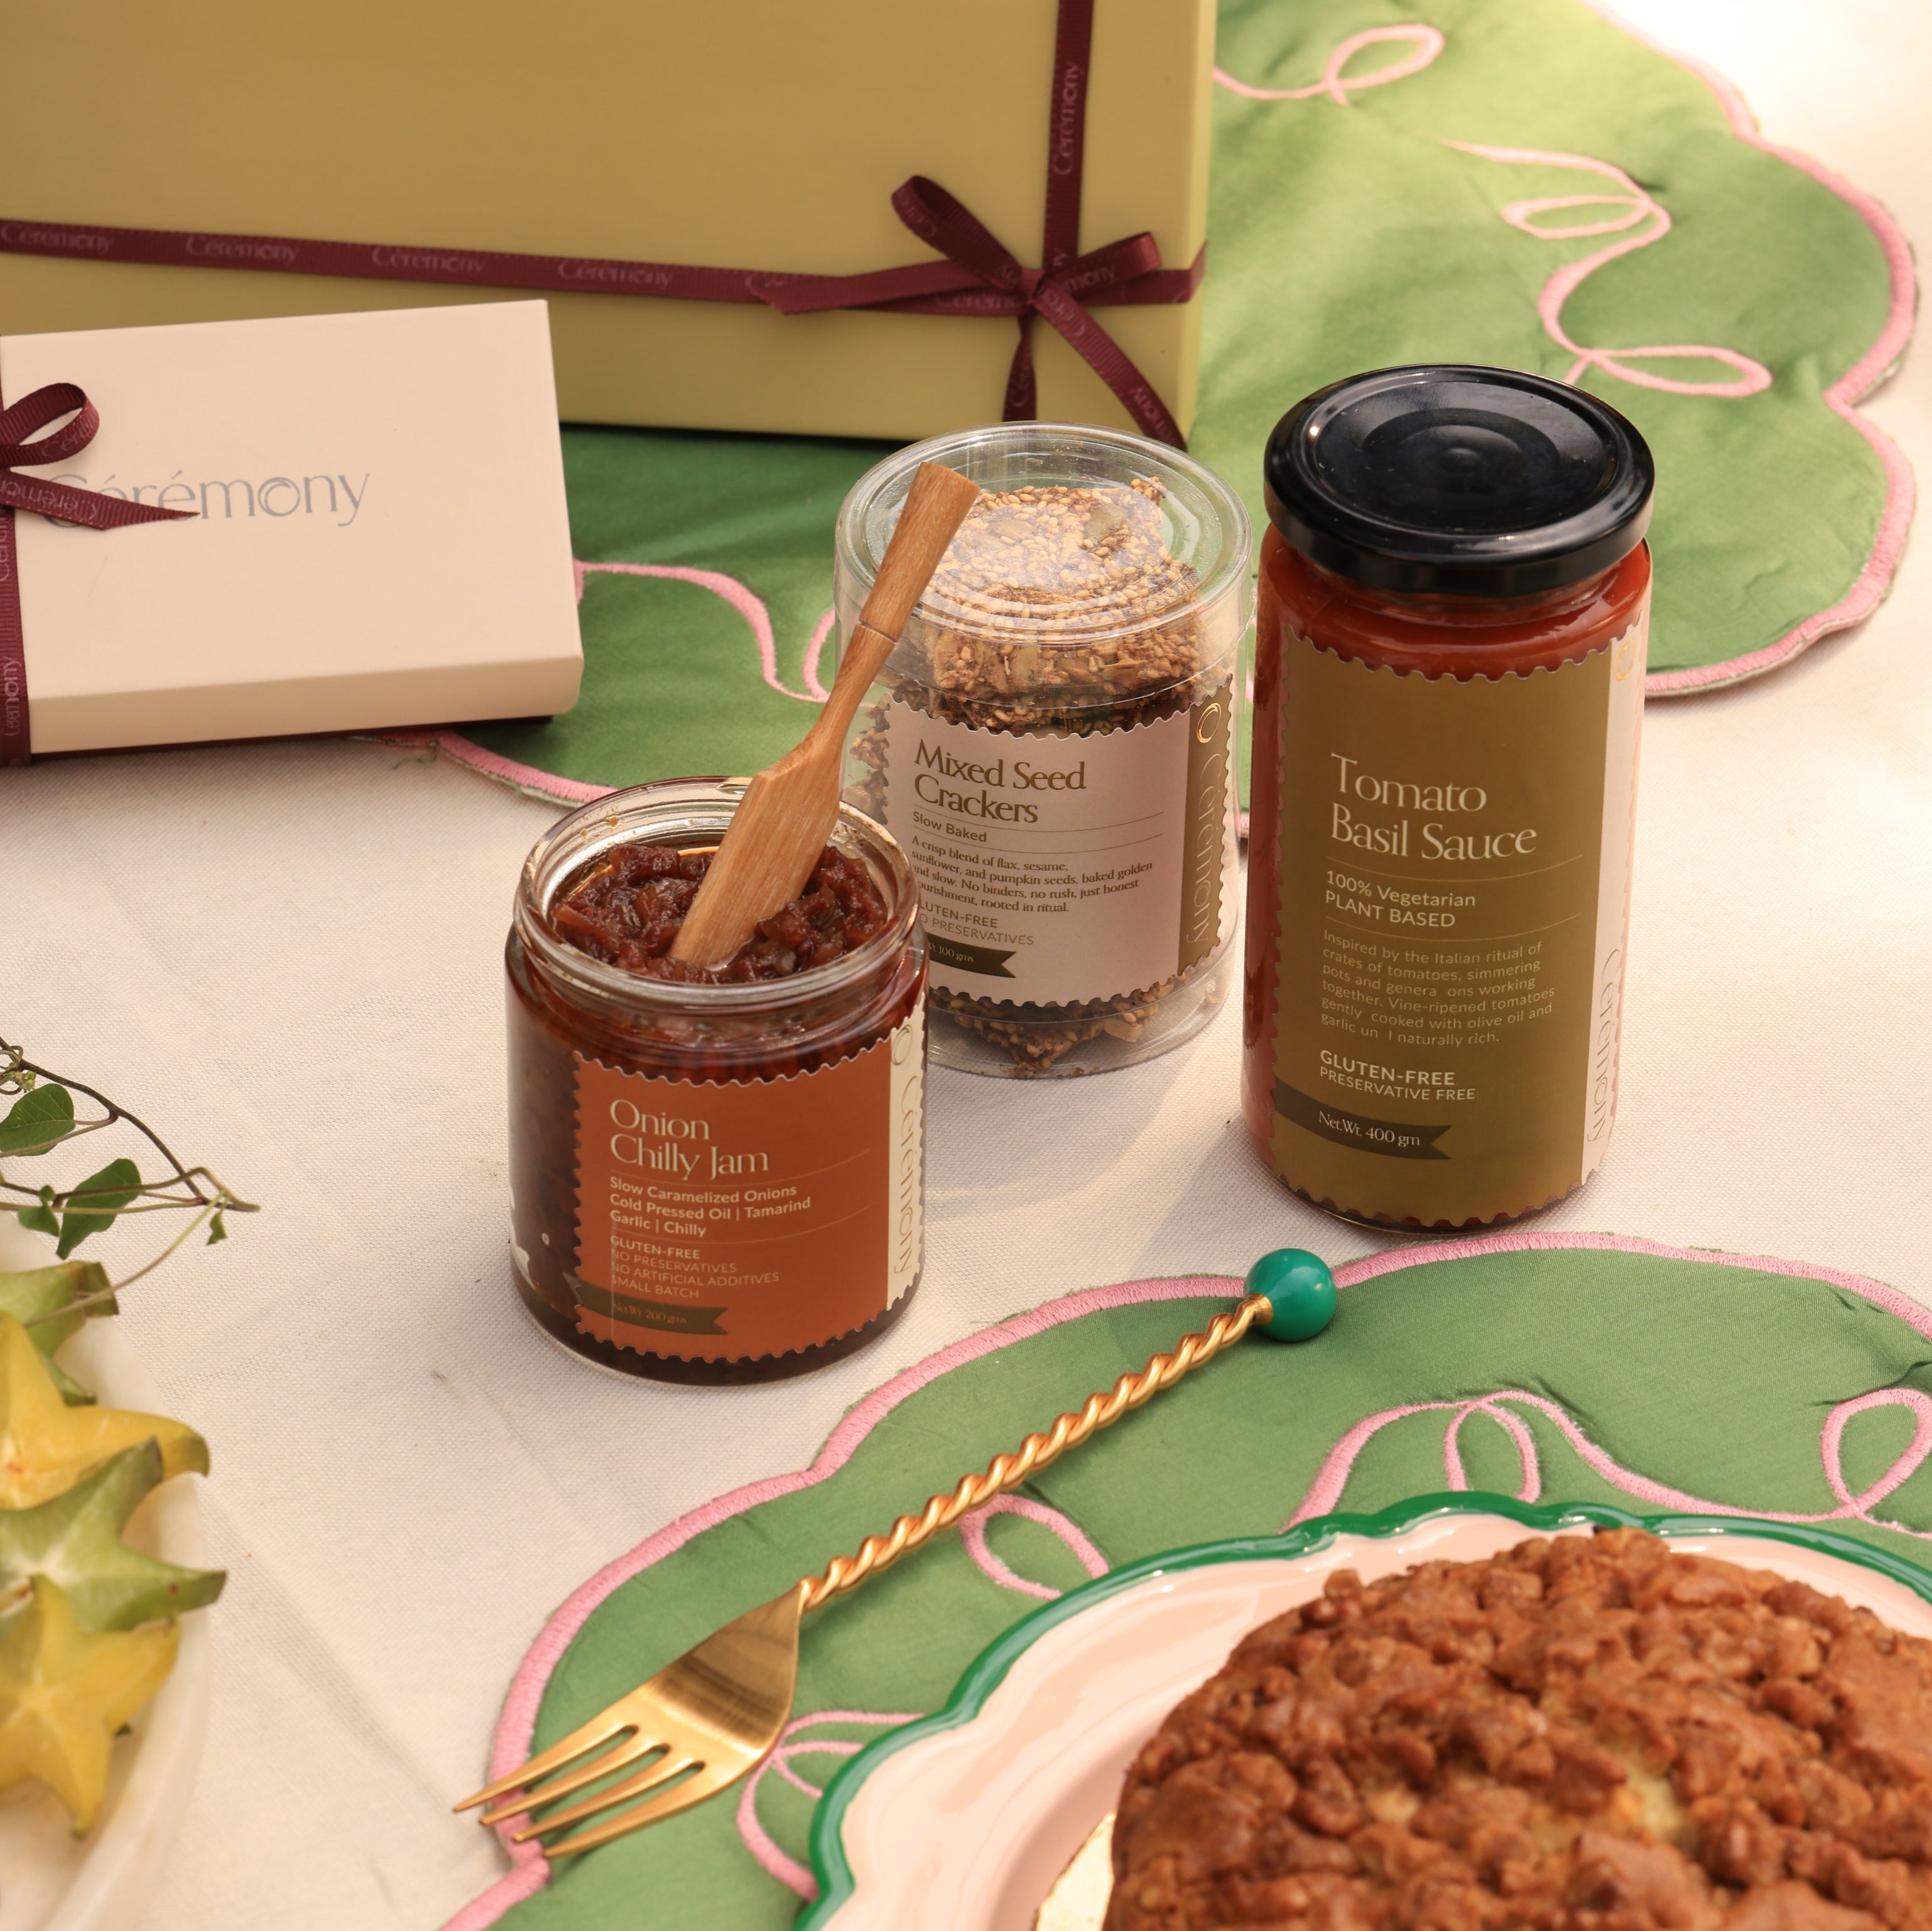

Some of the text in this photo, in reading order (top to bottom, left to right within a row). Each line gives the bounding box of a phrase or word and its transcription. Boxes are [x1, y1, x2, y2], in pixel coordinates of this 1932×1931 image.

[914, 739, 1087, 790] Mixed Seed
[1330, 751, 1487, 812] Tomato
[914, 774, 1038, 823] Crackers
[913, 811, 987, 842] Slow Baked
[1330, 802, 1538, 860] Basil Sauce
[912, 835, 1068, 871] A crisp blend of flax, sesame,
[912, 851, 1153, 886] sunflower, and pumpkin seeds, baked golden
[919, 881, 1069, 912] ourishment, rooted in ritual.
[932, 871, 957, 886] slow.
[962, 879, 979, 891] No
[983, 884, 1026, 898] binders,
[1050, 888, 1077, 898] rush,
[1080, 887, 1100, 899] just
[1104, 879, 1139, 894] honest
[1327, 870, 1475, 906] 100% Vegetarian
[1326, 889, 1456, 928] PLANT BASED
[933, 918, 1034, 945] PRESERVATIVES
[1324, 929, 1543, 964] Inspired by the Italian ritual of
[956, 952, 974, 963] gms
[1323, 949, 1541, 981] crates of tomatoes, simmering
[1323, 965, 1350, 981] pots
[1355, 976, 1381, 989] and
[1479, 978, 1536, 996] working
[1321, 998, 1552, 1029] gently cooked with olive oil and
[1323, 981, 1555, 1014] together. Vine-ripened tomatoes
[1321, 1014, 1355, 1033] garlic
[1398, 1034, 1463, 1047] naturally
[1468, 1032, 1499, 1044] rich.
[1320, 1050, 1455, 1085] GLUTEN-FREE
[1320, 1066, 1475, 1100] PRESERVATIVE FREE
[610, 1099, 710, 1140] Onion
[1365, 1128, 1395, 1143] 400
[1398, 1136, 1420, 1148] gm
[611, 1133, 769, 1180] Chilly Jam
[610, 1177, 797, 1203] Slow Caramelized Onions
[610, 1194, 642, 1211] Cold
[647, 1202, 704, 1219] Pressed
[709, 1207, 730, 1220] Oil
[744, 1197, 811, 1218] Tamarind
[610, 1210, 651, 1229] Garlic
[664, 1221, 707, 1237] Chilly
[611, 1236, 700, 1259] GLUTEN-FREE
[634, 1255, 737, 1273] PRESERVATIVES
[634, 1268, 703, 1286] ARTIFICIAL
[707, 1272, 779, 1286] ADDITIVES
[611, 1274, 699, 1298] SMALL BATCH
